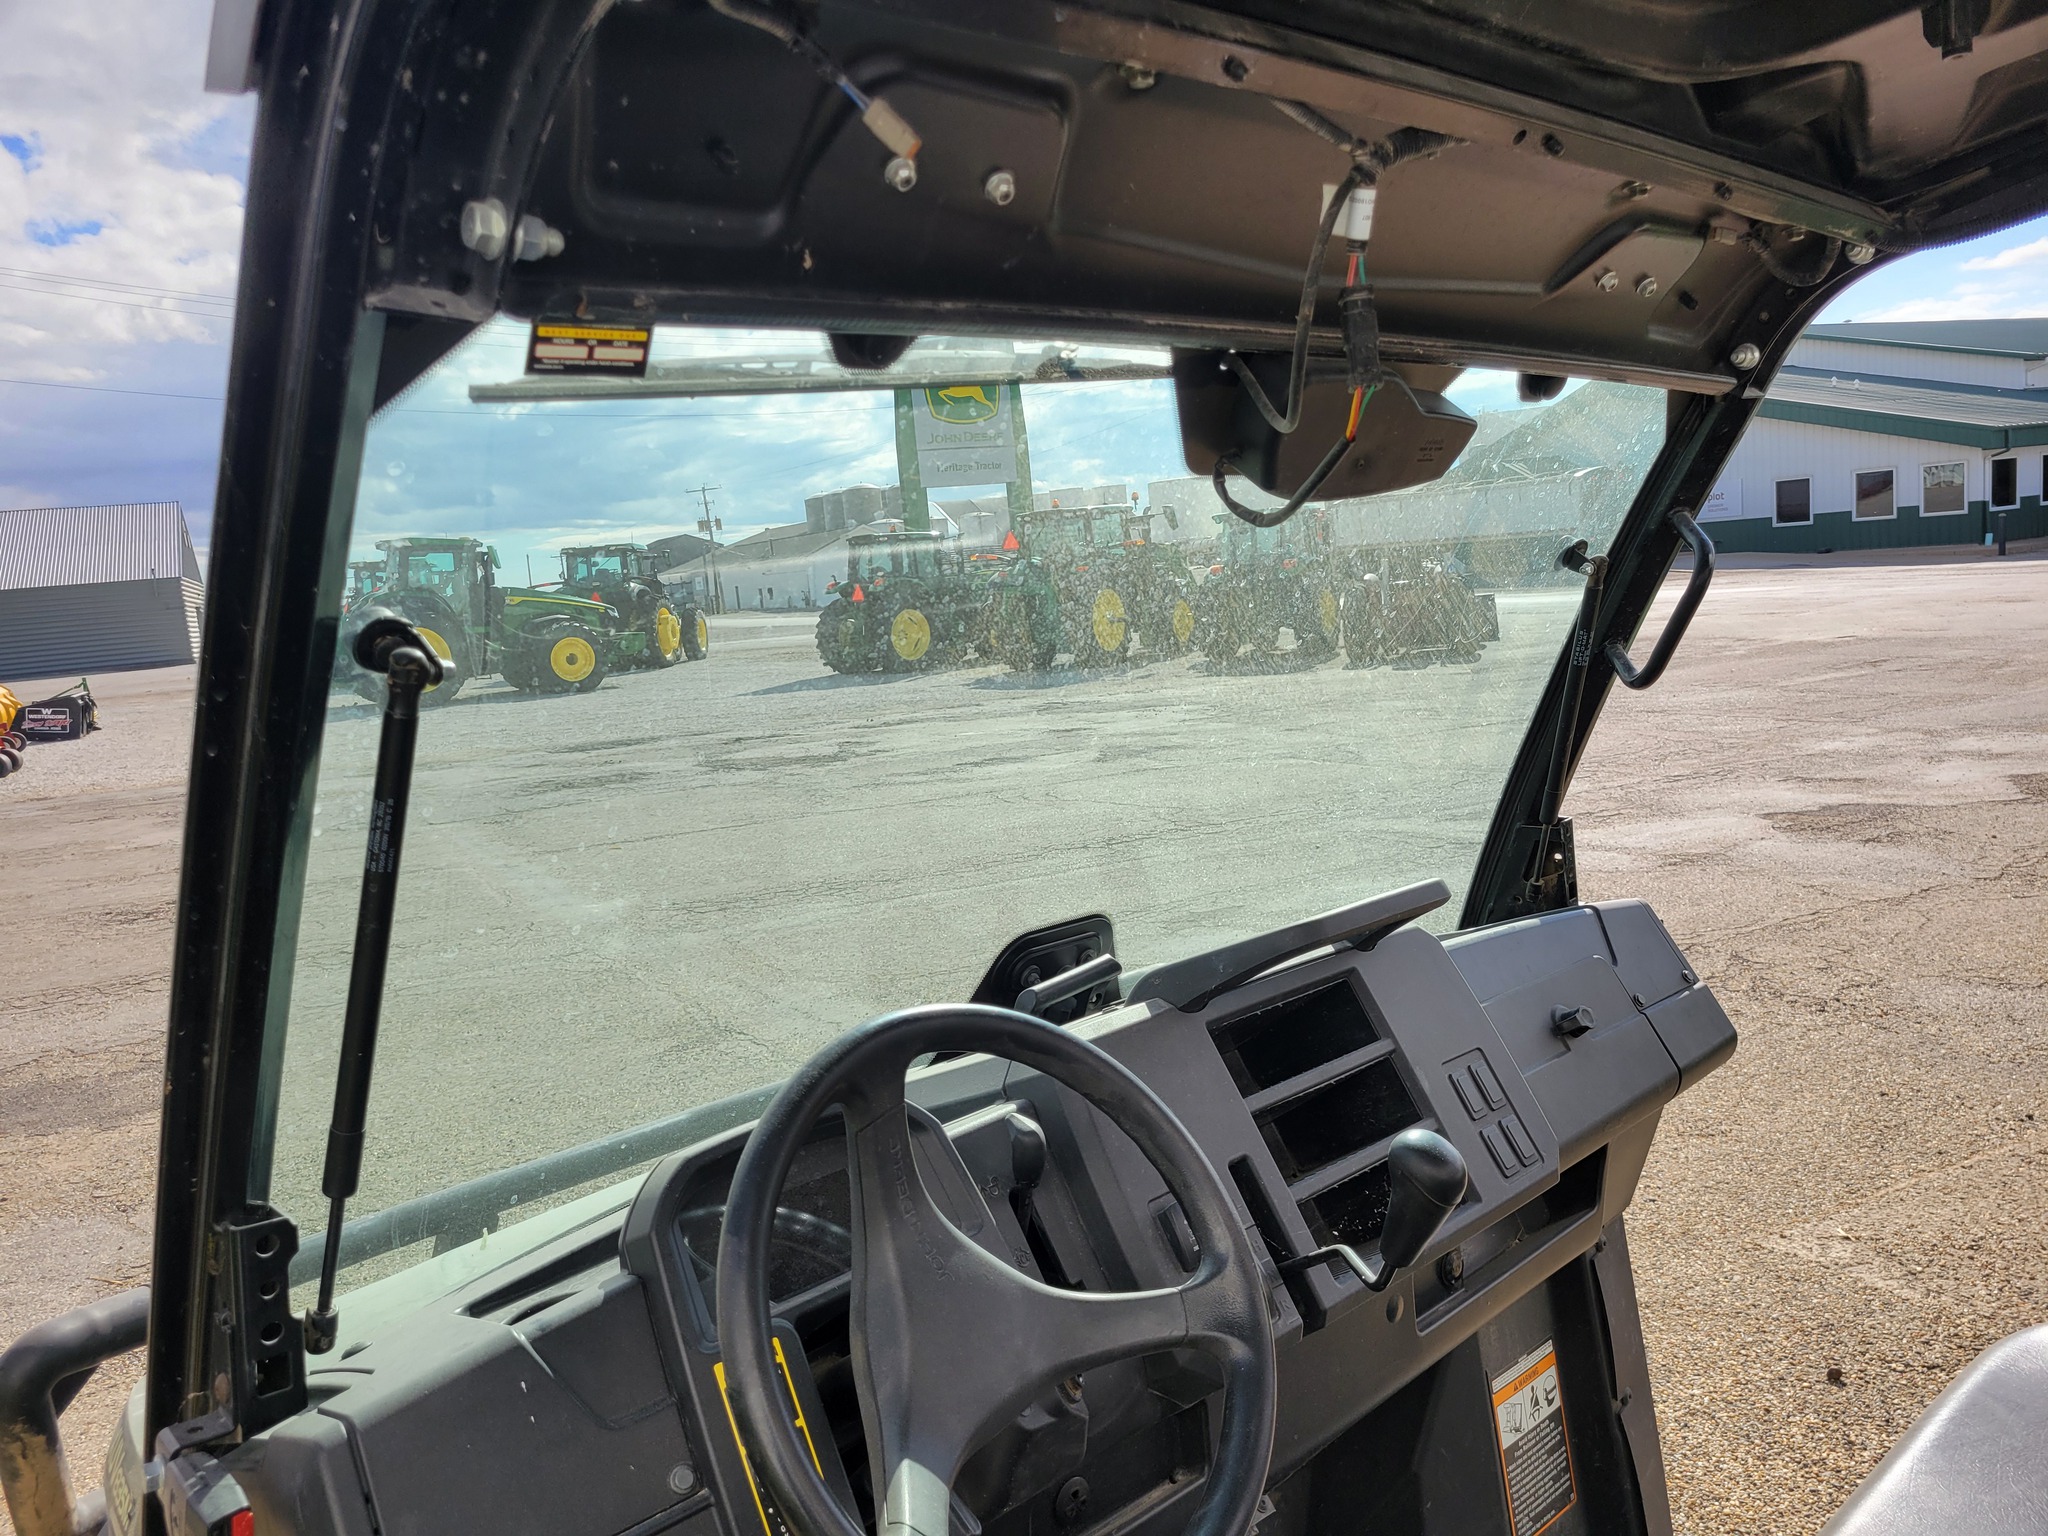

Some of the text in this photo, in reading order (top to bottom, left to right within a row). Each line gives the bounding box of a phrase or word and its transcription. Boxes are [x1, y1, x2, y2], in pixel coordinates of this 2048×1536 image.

[927, 432, 962, 445] JOHN
[937, 461, 1002, 473] Heritage Tractor
[1573, 631, 1583, 665] STABILUS
